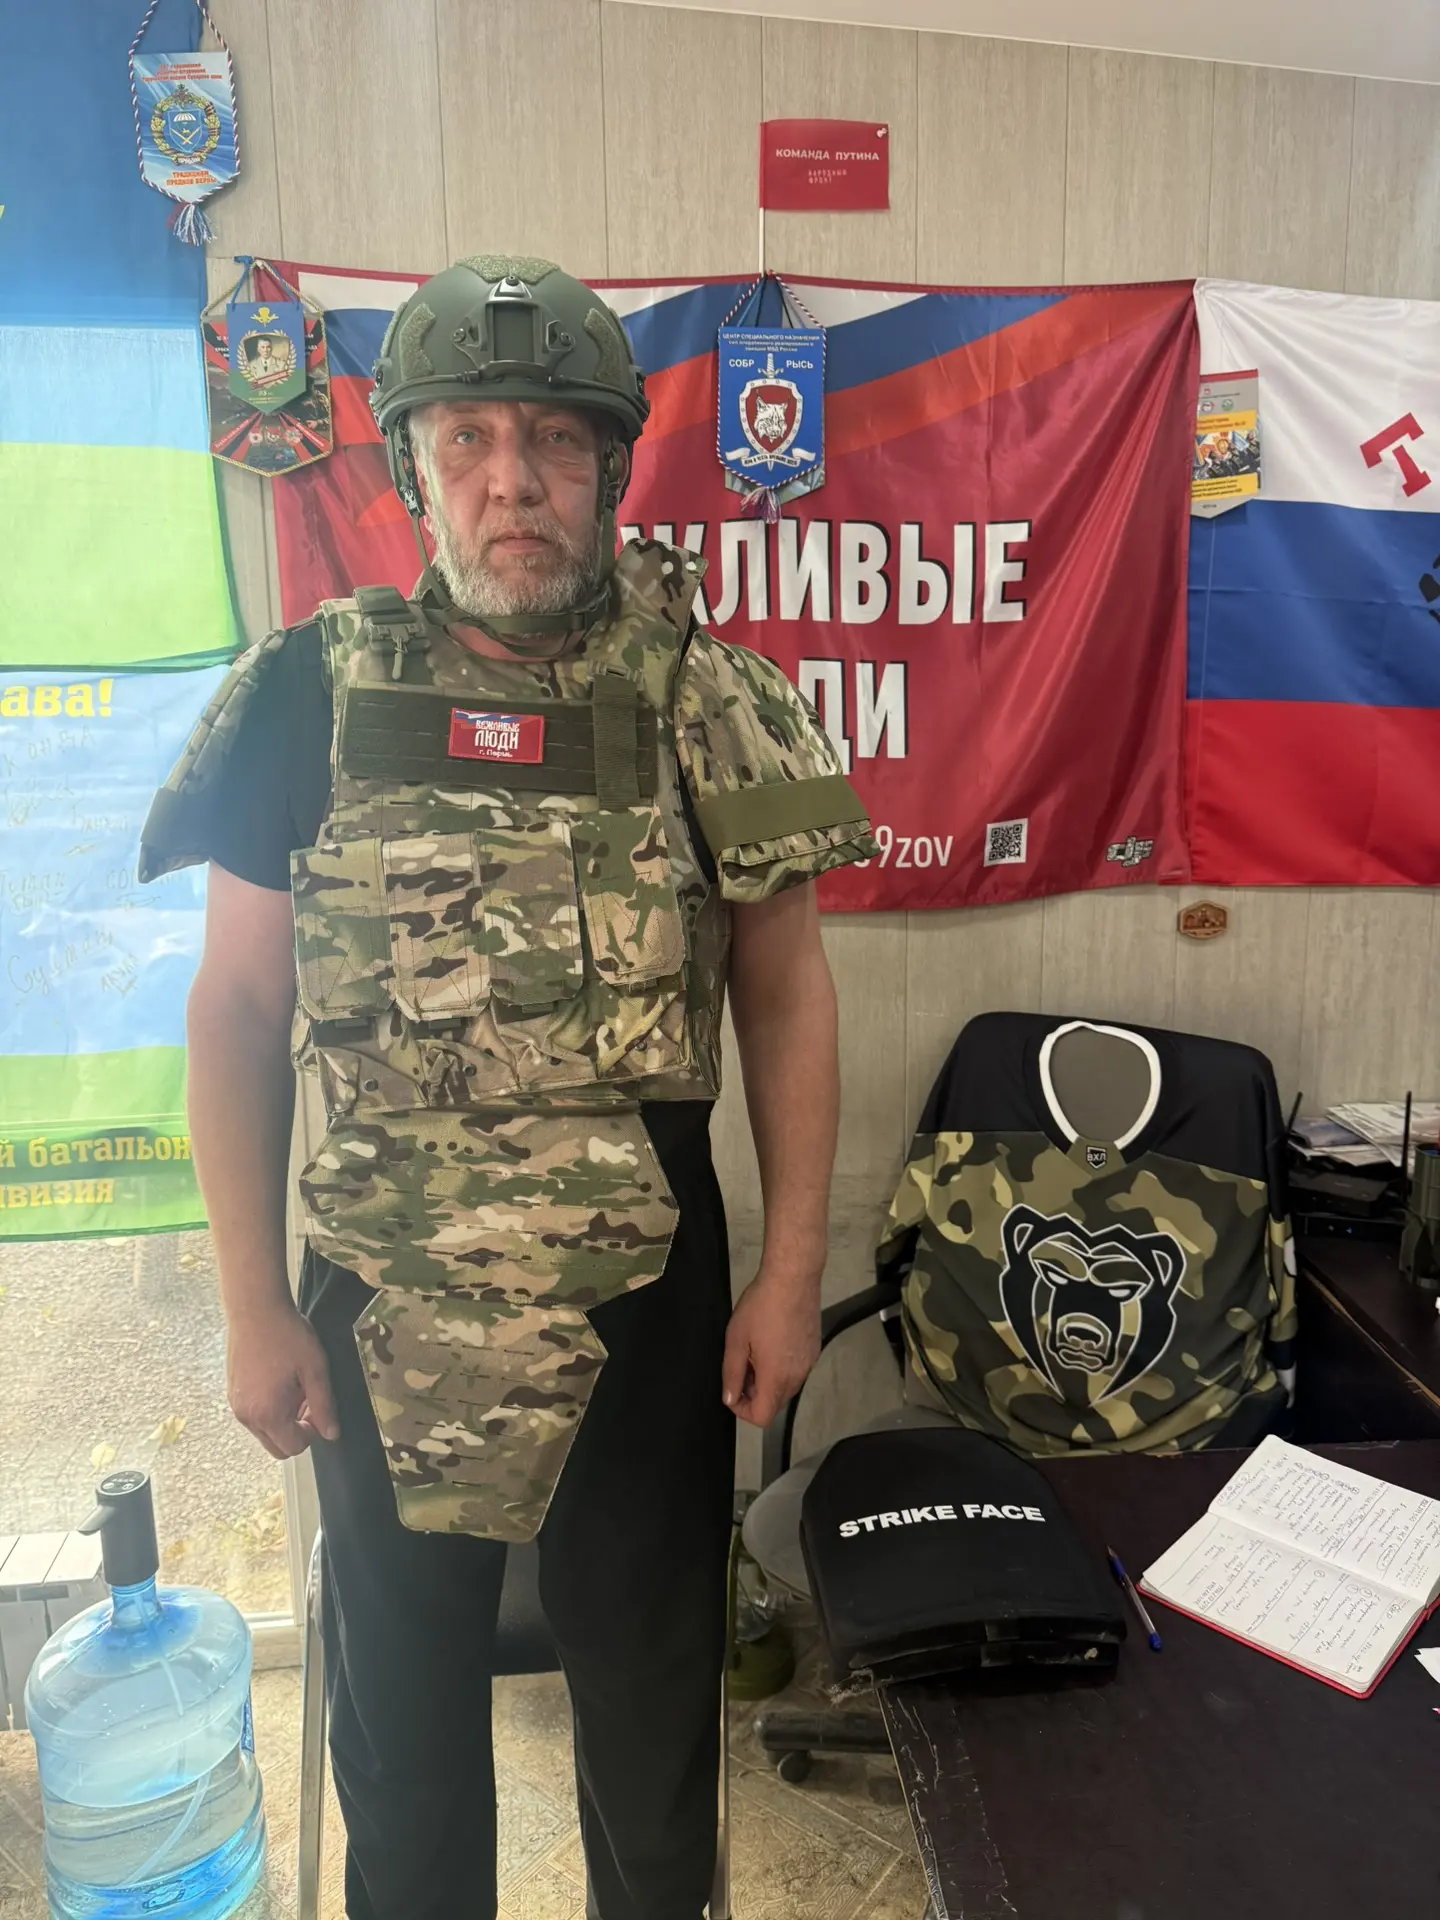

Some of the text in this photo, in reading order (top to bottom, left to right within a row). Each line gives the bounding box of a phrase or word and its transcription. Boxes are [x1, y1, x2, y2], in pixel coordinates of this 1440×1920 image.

[775, 148, 880, 161] КОМАНДА ПУТИНА
[740, 333, 785, 341] СПЕЦИАЛЬНОГО
[728, 358, 814, 369] СОБР РЫСЬ
[0, 679, 114, 717] ава!
[475, 719, 520, 732] ВЕЖЛИВЫЕ
[474, 730, 519, 751] ЛЮДИ
[854, 824, 954, 868] 9zov
[28, 1135, 192, 1169] батальон
[1087, 1153, 1106, 1162] ВХЛ
[839, 1503, 1046, 1538] STRIKE FACE
